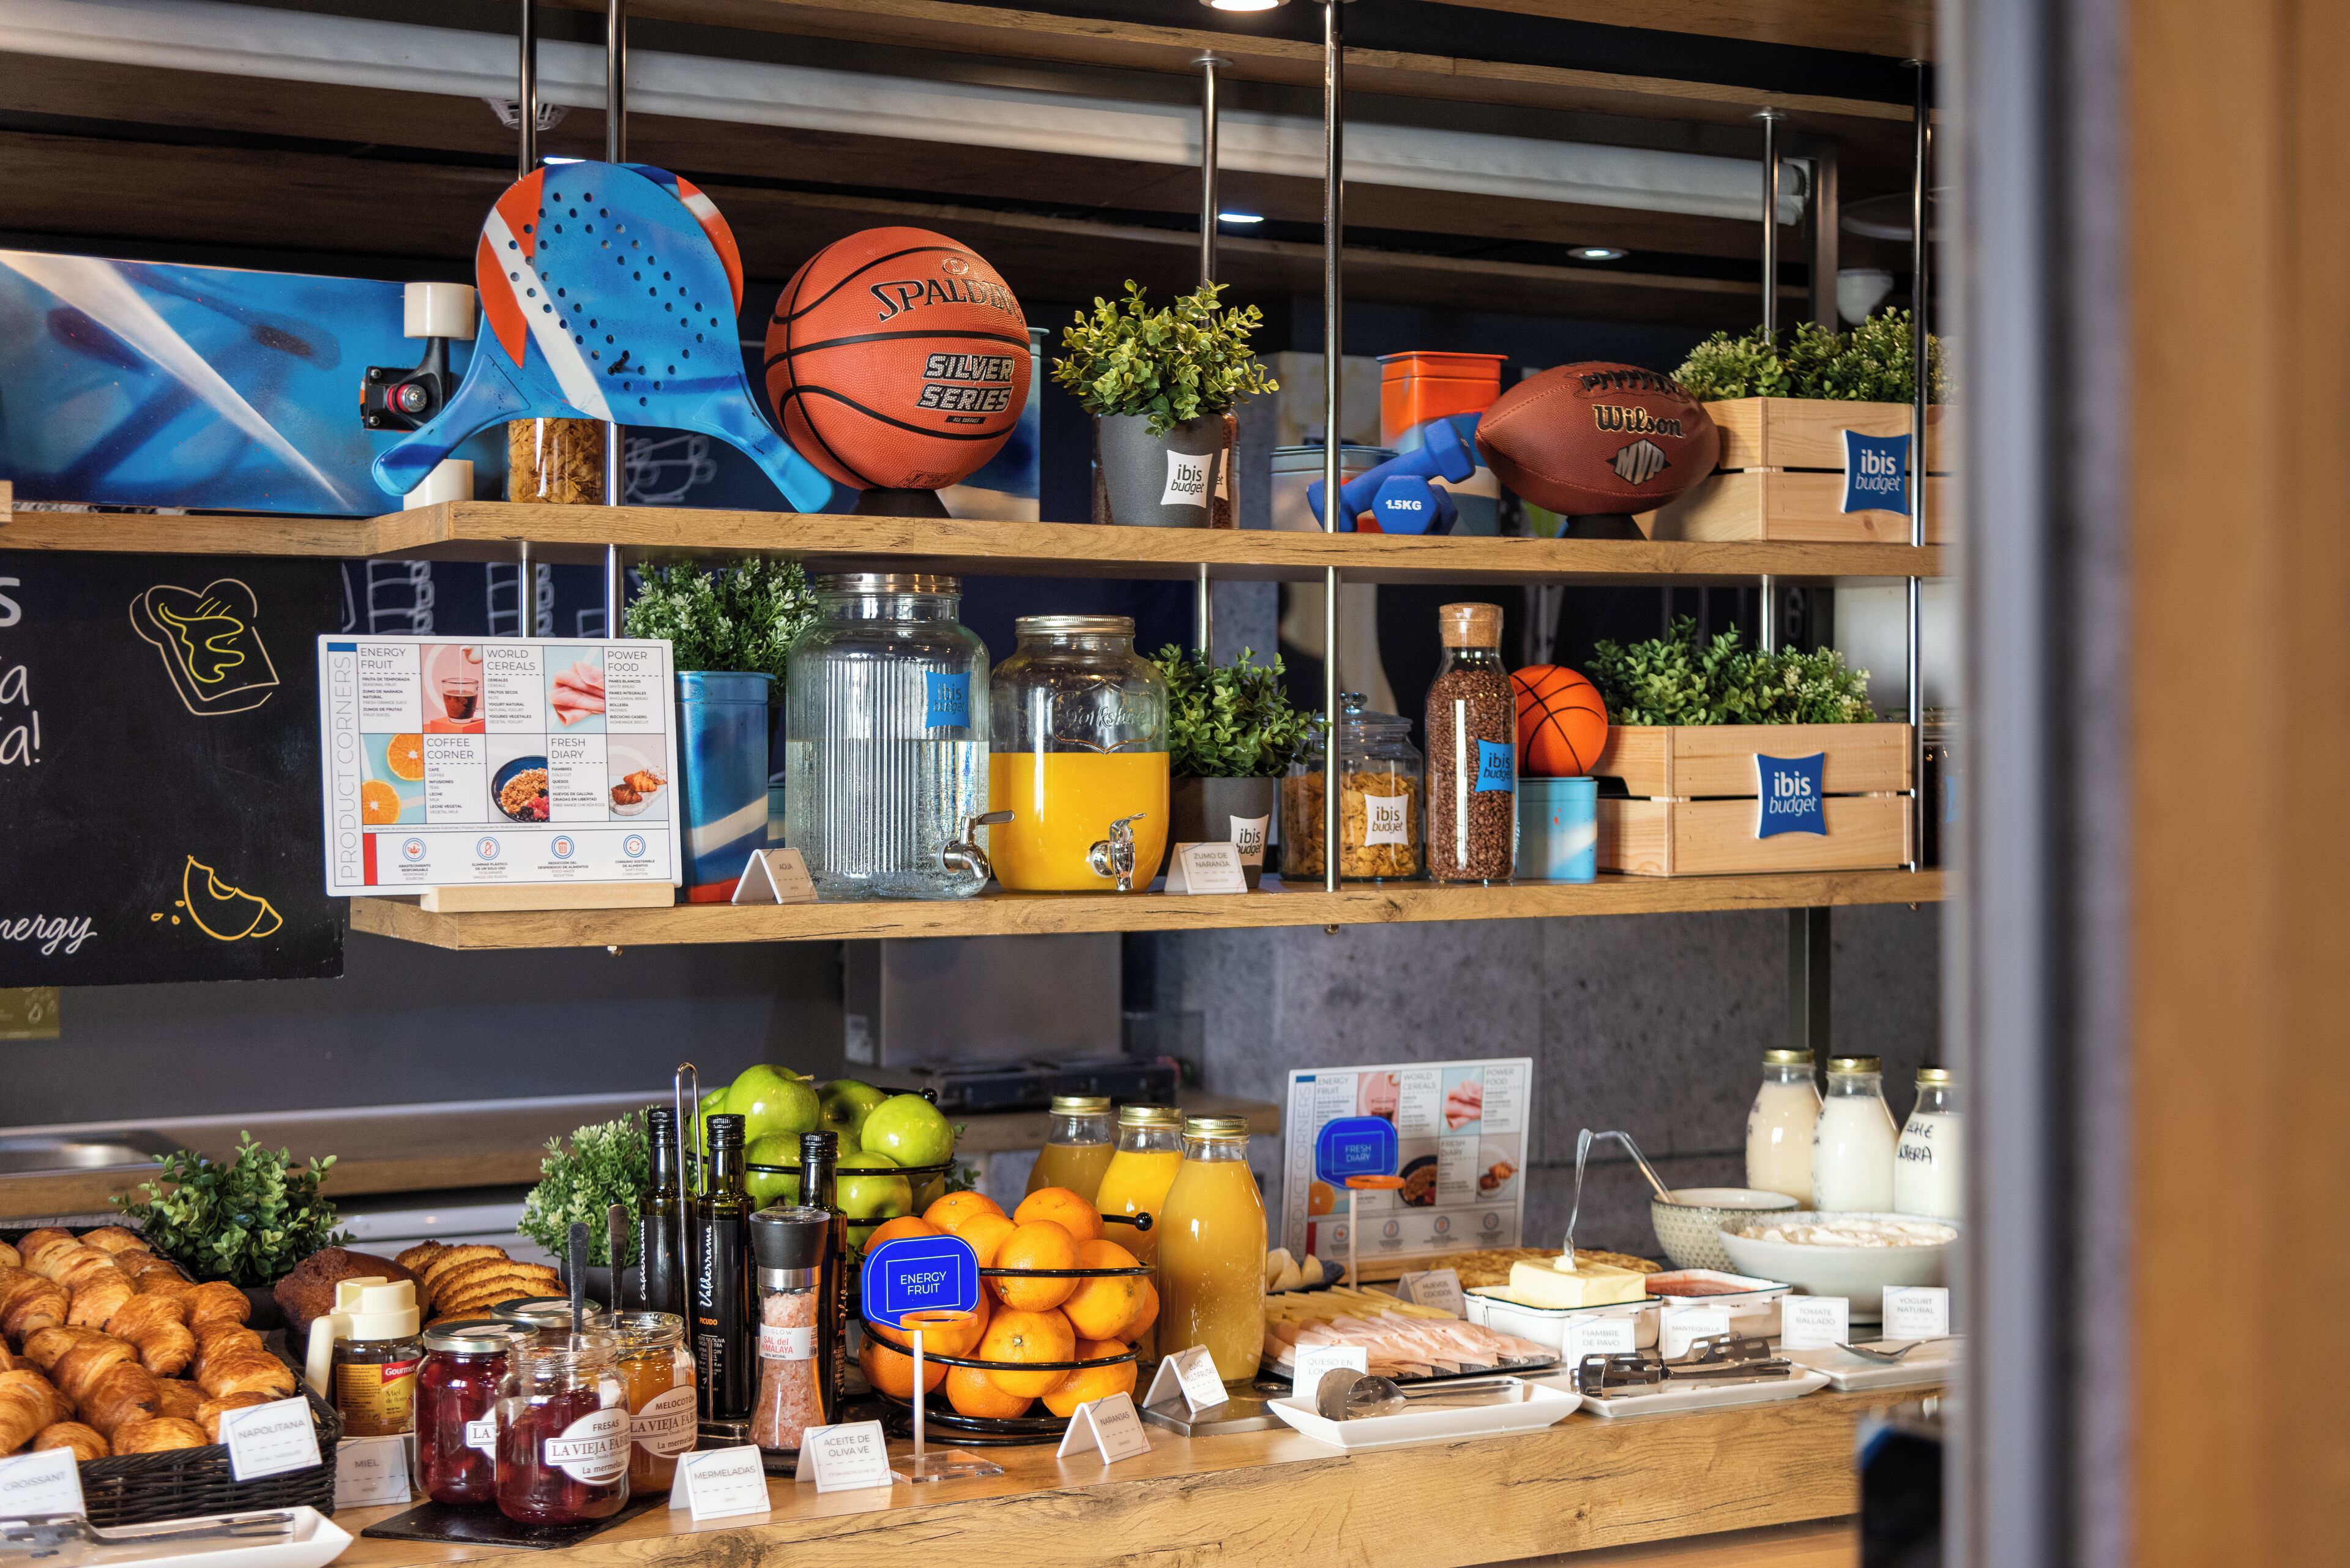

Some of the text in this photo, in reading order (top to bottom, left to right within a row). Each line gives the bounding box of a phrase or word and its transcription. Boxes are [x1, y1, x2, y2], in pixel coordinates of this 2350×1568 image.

[923, 353, 1013, 383] SILVER
[916, 384, 1013, 412] SERIES
[1592, 404, 1683, 437] Wilson
[1613, 438, 1666, 485] MVP
[1860, 450, 1896, 475] ibis
[1177, 464, 1202, 482] ibis
[1171, 479, 1204, 495] budget
[1856, 473, 1901, 495] budget
[1385, 498, 1422, 510] 1.5KG
[360, 648, 406, 657] ENERGY
[487, 649, 529, 659] WORLD
[608, 651, 647, 660] POWER
[361, 660, 393, 669] FRUIT
[487, 662, 535, 671] CEREALS
[608, 663, 639, 671] FOOD
[938, 683, 962, 700] ibis
[427, 738, 470, 747] COFFEE
[551, 738, 585, 747] FRESH
[427, 750, 474, 759] CORNER
[551, 750, 583, 759] DIARY
[1489, 752, 1510, 768] ibis
[334, 657, 357, 878] PRODUCT CORNERS
[1774, 771, 1811, 797] ibis
[1769, 794, 1817, 816] budget
[1376, 806, 1400, 821] ibis
[1371, 819, 1403, 834] budget
[1240, 828, 1261, 843] ibis
[1318, 1077, 1349, 1085] ENERGY
[1404, 1072, 1432, 1081] WORLD
[1403, 1082, 1436, 1091] CEREALS
[1345, 1144, 1371, 1153] FRESH
[1346, 1153, 1371, 1162] DIARY
[698, 1225, 714, 1307] Valderrama
[900, 1271, 947, 1285] ENERGY
[908, 1283, 940, 1296] FRUIT
[1899, 1297, 1933, 1305] YOGURT
[699, 1317, 718, 1326] PICUDO
[1796, 1317, 1835, 1326] RALLADO
[764, 1335, 774, 1345] SAL
[761, 1343, 793, 1353] HIMALAYA
[385, 1365, 416, 1376] Gourmet
[1189, 1360, 1203, 1371] ZUMO
[1184, 1367, 1215, 1382] MULTIFRUTAS
[655, 1394, 695, 1410] MELOCOTÓN
[630, 1421, 646, 1433] LA
[648, 1417, 679, 1431] VIEJA
[1100, 1411, 1130, 1426] NARANJAS
[238, 1419, 305, 1439] NAPOLITANA
[593, 1419, 619, 1432] FRESAS
[473, 1428, 490, 1439] LA
[668, 1434, 695, 1448] mermelada
[824, 1435, 870, 1446] ACEITE DE
[552, 1445, 568, 1457] LA
[573, 1440, 606, 1455] VIEJA
[829, 1445, 870, 1457] OLIVA VE
[355, 1459, 379, 1468] MIEL
[594, 1460, 625, 1473] mermelada
[695, 1466, 755, 1480] MERMELADAS
[2, 1471, 67, 1492] CROISSANT
